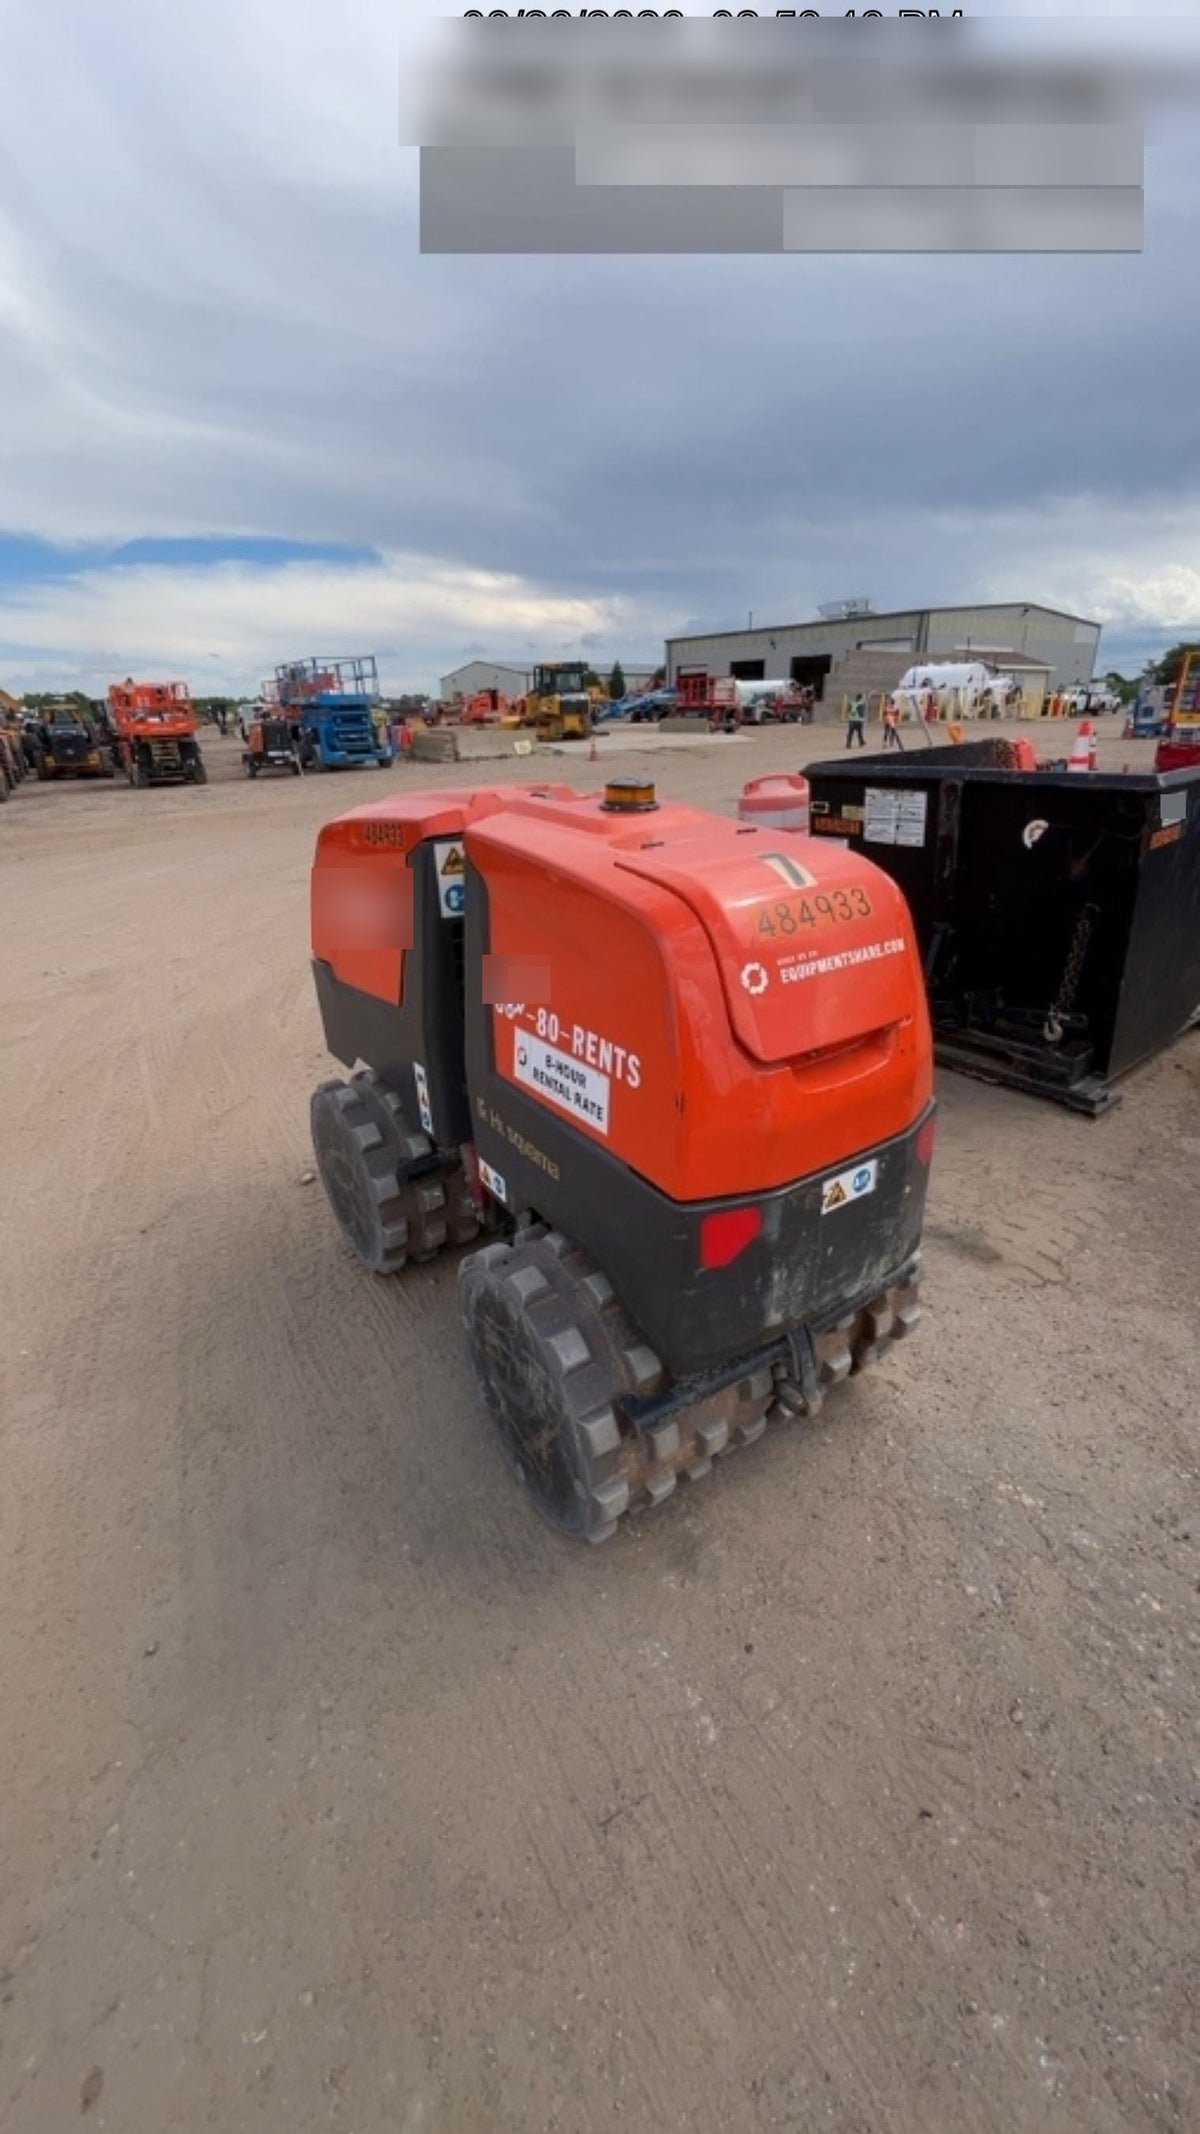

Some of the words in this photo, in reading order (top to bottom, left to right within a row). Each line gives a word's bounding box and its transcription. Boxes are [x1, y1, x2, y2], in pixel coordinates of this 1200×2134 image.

[758, 889, 872, 937] 484933
[780, 938, 905, 984] EQUIPMENTSHARE.COM
[495, 1003, 641, 1088] -80-RENTS
[533, 1066, 571, 1101] RENTAL
[574, 1091, 604, 1122] RATE
